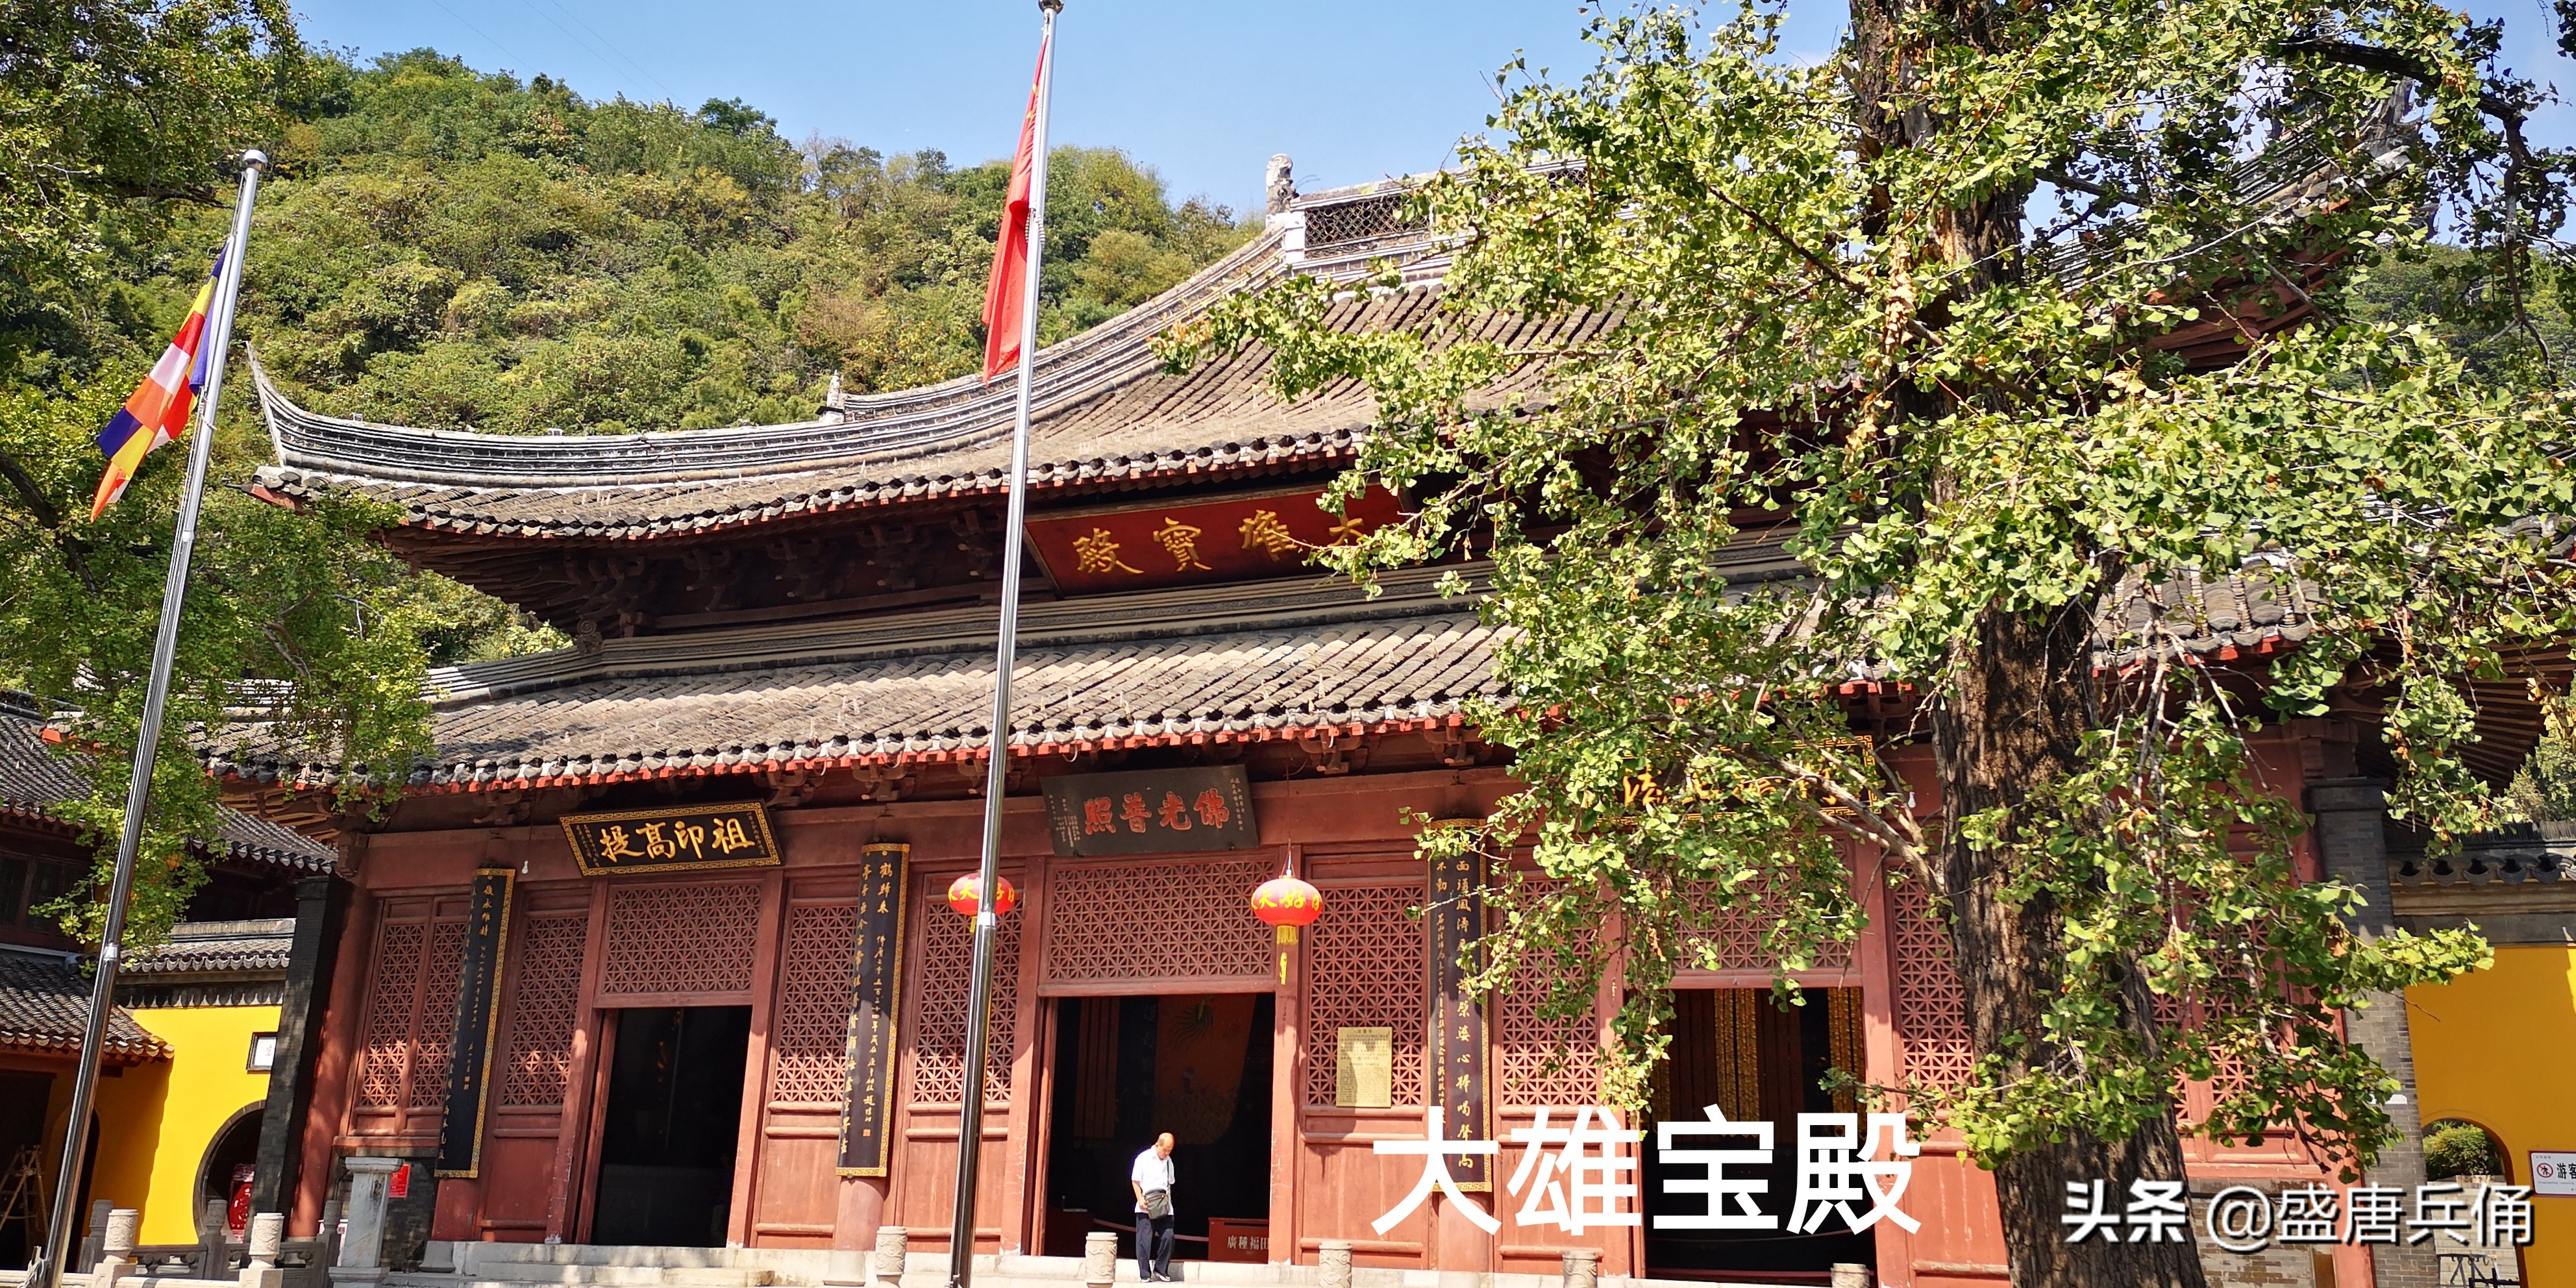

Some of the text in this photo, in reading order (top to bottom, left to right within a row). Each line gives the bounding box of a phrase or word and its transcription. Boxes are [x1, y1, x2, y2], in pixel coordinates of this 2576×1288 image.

[1084, 788, 1229, 835] 佛光普照
[599, 817, 755, 863] 祖印高提
[1227, 1235, 1269, 1250] 廣種福田
